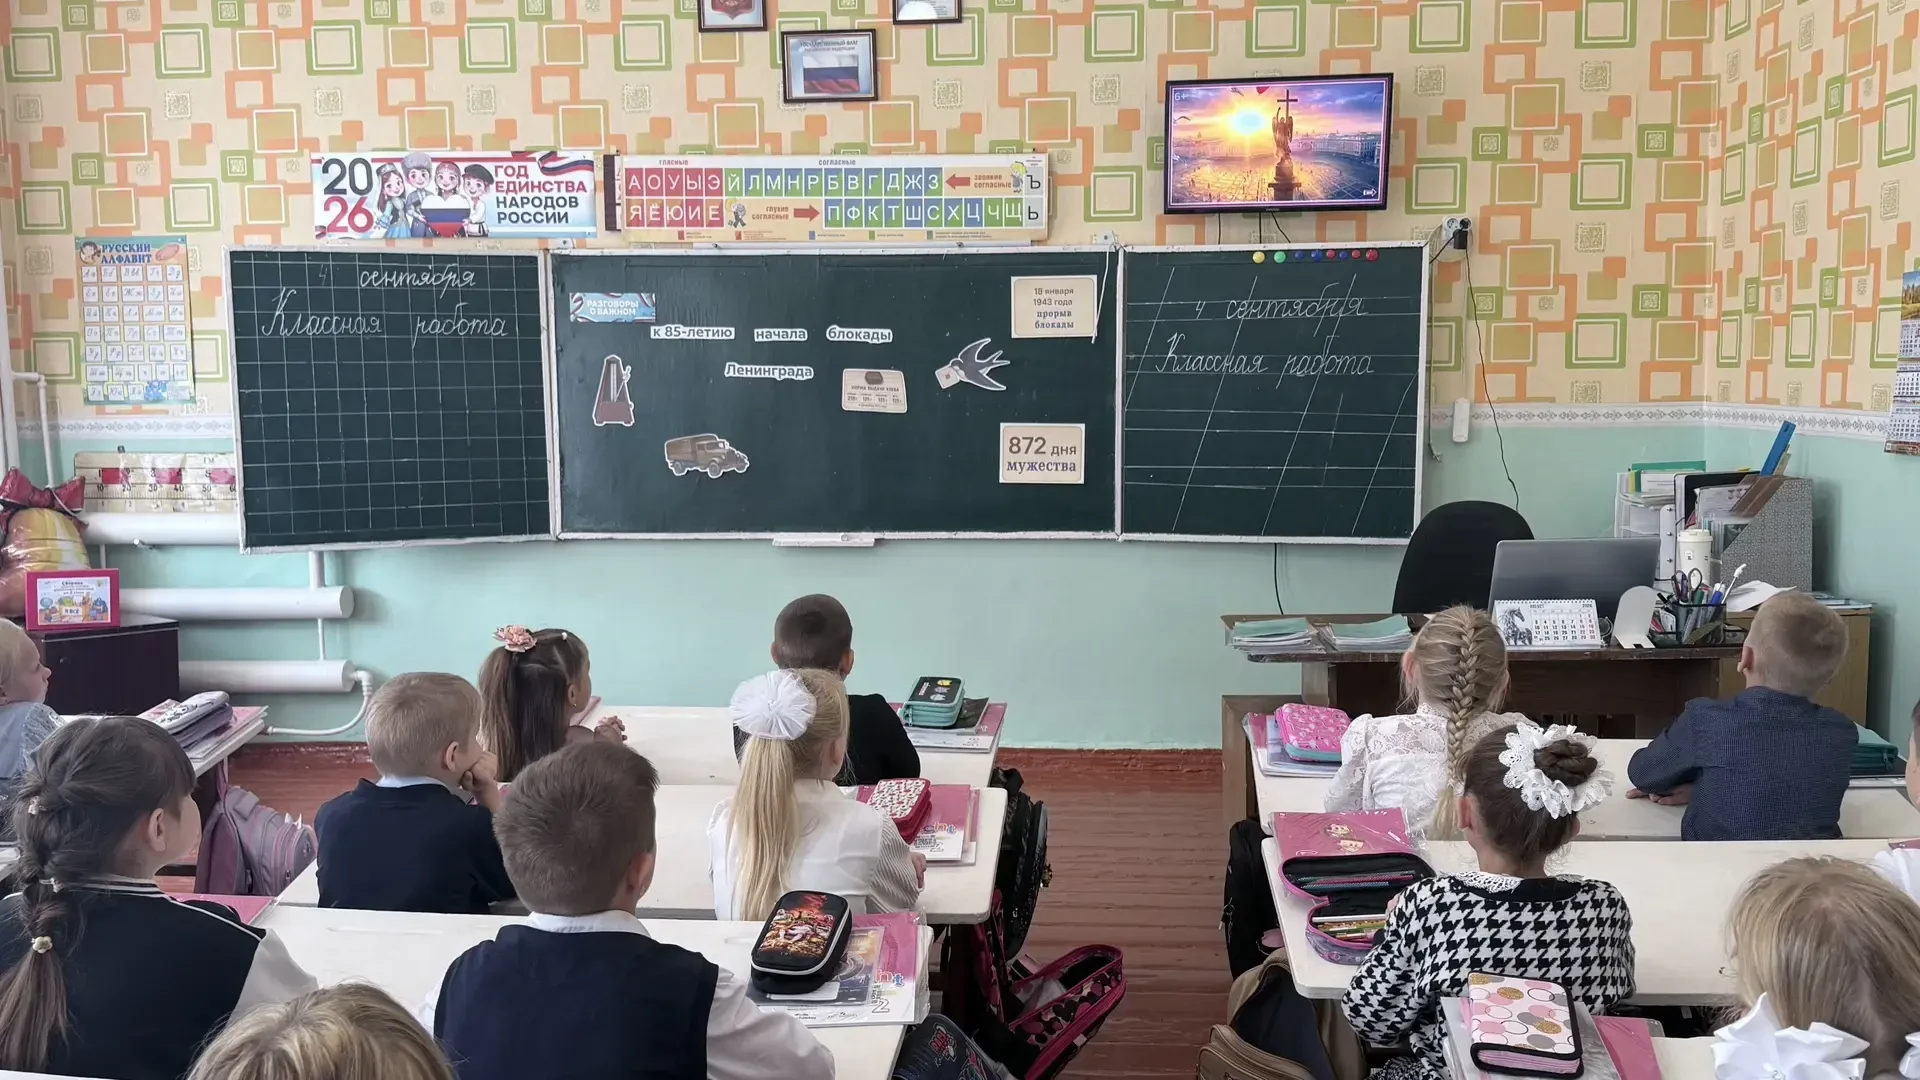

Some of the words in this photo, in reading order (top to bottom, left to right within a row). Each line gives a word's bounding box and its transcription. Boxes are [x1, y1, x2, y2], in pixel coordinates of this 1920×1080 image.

[1174, 92, 1187, 100] 6+
[322, 157, 374, 196] 20
[494, 165, 529, 179] ГОД
[495, 181, 588, 194] ЕДИНСТВА
[1026, 175, 1041, 190] Ъ
[496, 196, 580, 210] НАРОДОВ
[323, 196, 374, 232] 26
[497, 211, 570, 224] РОССИИ
[1028, 206, 1039, 220] Ь
[102, 244, 151, 253] РУССКИЙ
[102, 254, 152, 264] АЛФАВИТ
[318, 264, 327, 286] 4
[360, 263, 476, 299] сентября
[1034, 288, 1043, 296] 18
[1044, 288, 1074, 297] января
[587, 300, 639, 308] РАЗГОВОРЫ
[1196, 300, 1205, 320] 4
[1226, 282, 1368, 337] сентября
[262, 287, 383, 338] Классная
[412, 302, 508, 350] работа
[590, 308, 596, 316] О
[598, 308, 636, 316] ВАЖНОМ
[1036, 310, 1072, 320] прорыв
[1034, 320, 1074, 330] блокады
[653, 328, 661, 338] к
[664, 326, 734, 338] 85-летию
[756, 329, 807, 341] начала
[828, 326, 893, 343] блокады
[1156, 332, 1268, 373] Классная
[1276, 335, 1374, 390] работа
[725, 364, 813, 380] Ленинграда
[1008, 436, 1047, 455] 872
[1051, 444, 1077, 457] дня
[1006, 460, 1077, 474] мужества
[96, 484, 104, 492] 10
[174, 484, 184, 492] 40
[872, 998, 890, 1013] 2
